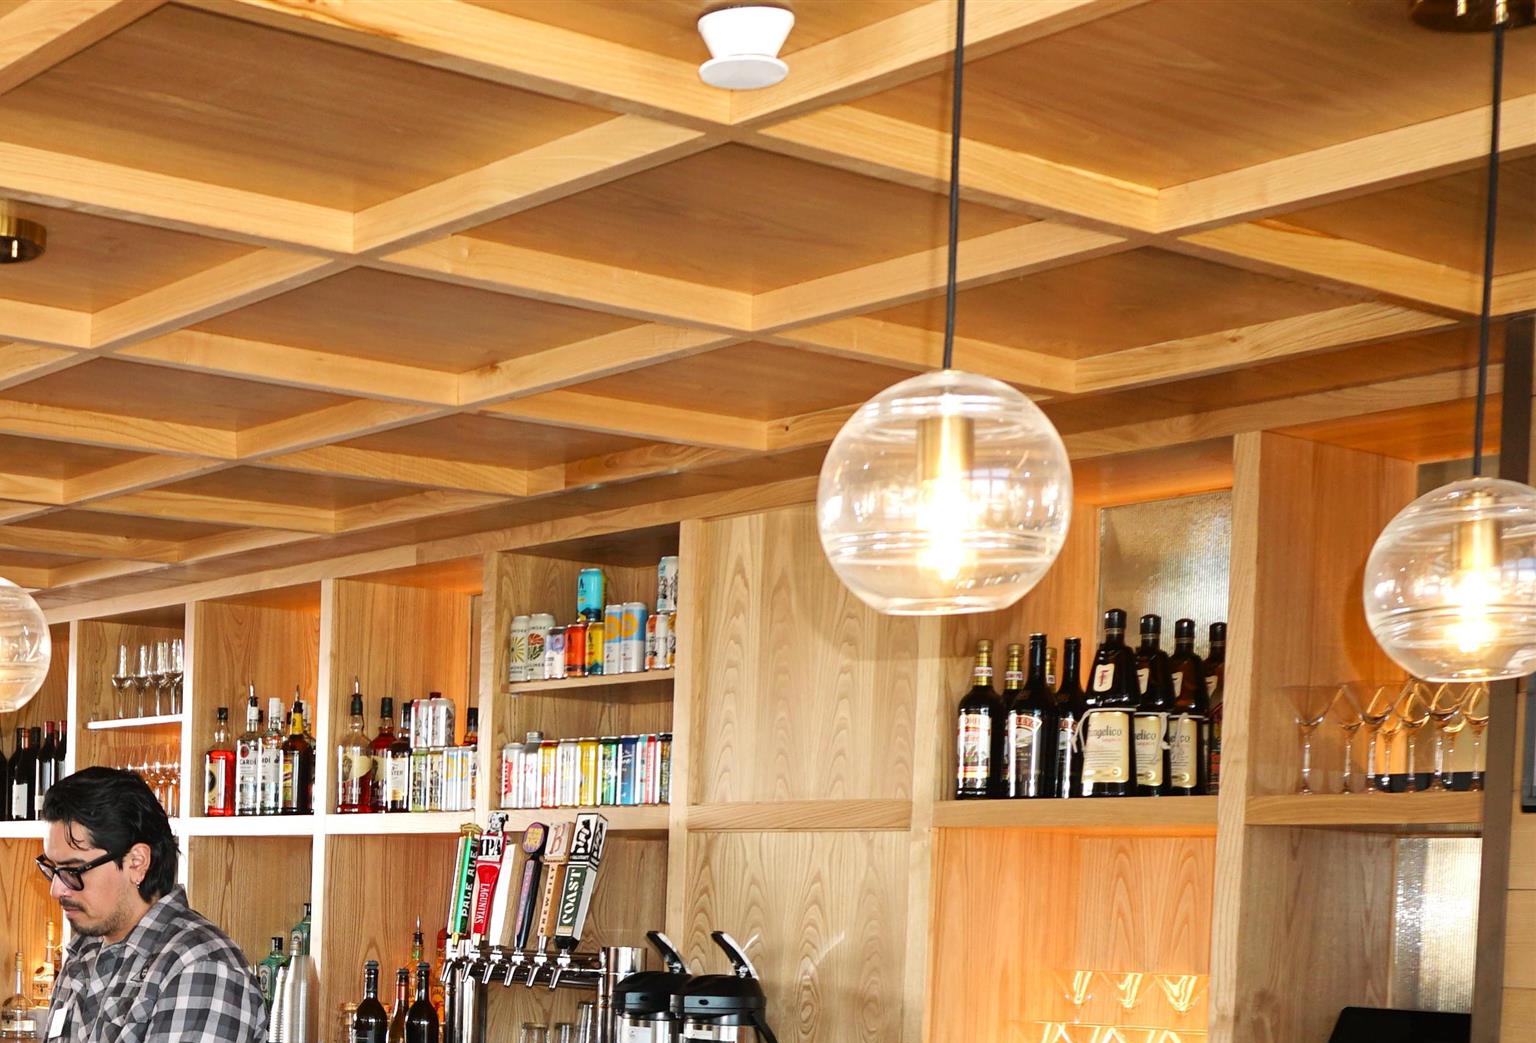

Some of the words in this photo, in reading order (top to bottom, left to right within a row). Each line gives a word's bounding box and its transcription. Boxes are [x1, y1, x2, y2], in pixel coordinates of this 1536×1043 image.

[467, 851, 478, 877] ALE
[479, 836, 502, 857] IPA
[461, 882, 474, 918] PALE
[474, 882, 491, 925] LAGUNITAS
[561, 868, 582, 925] COAST
